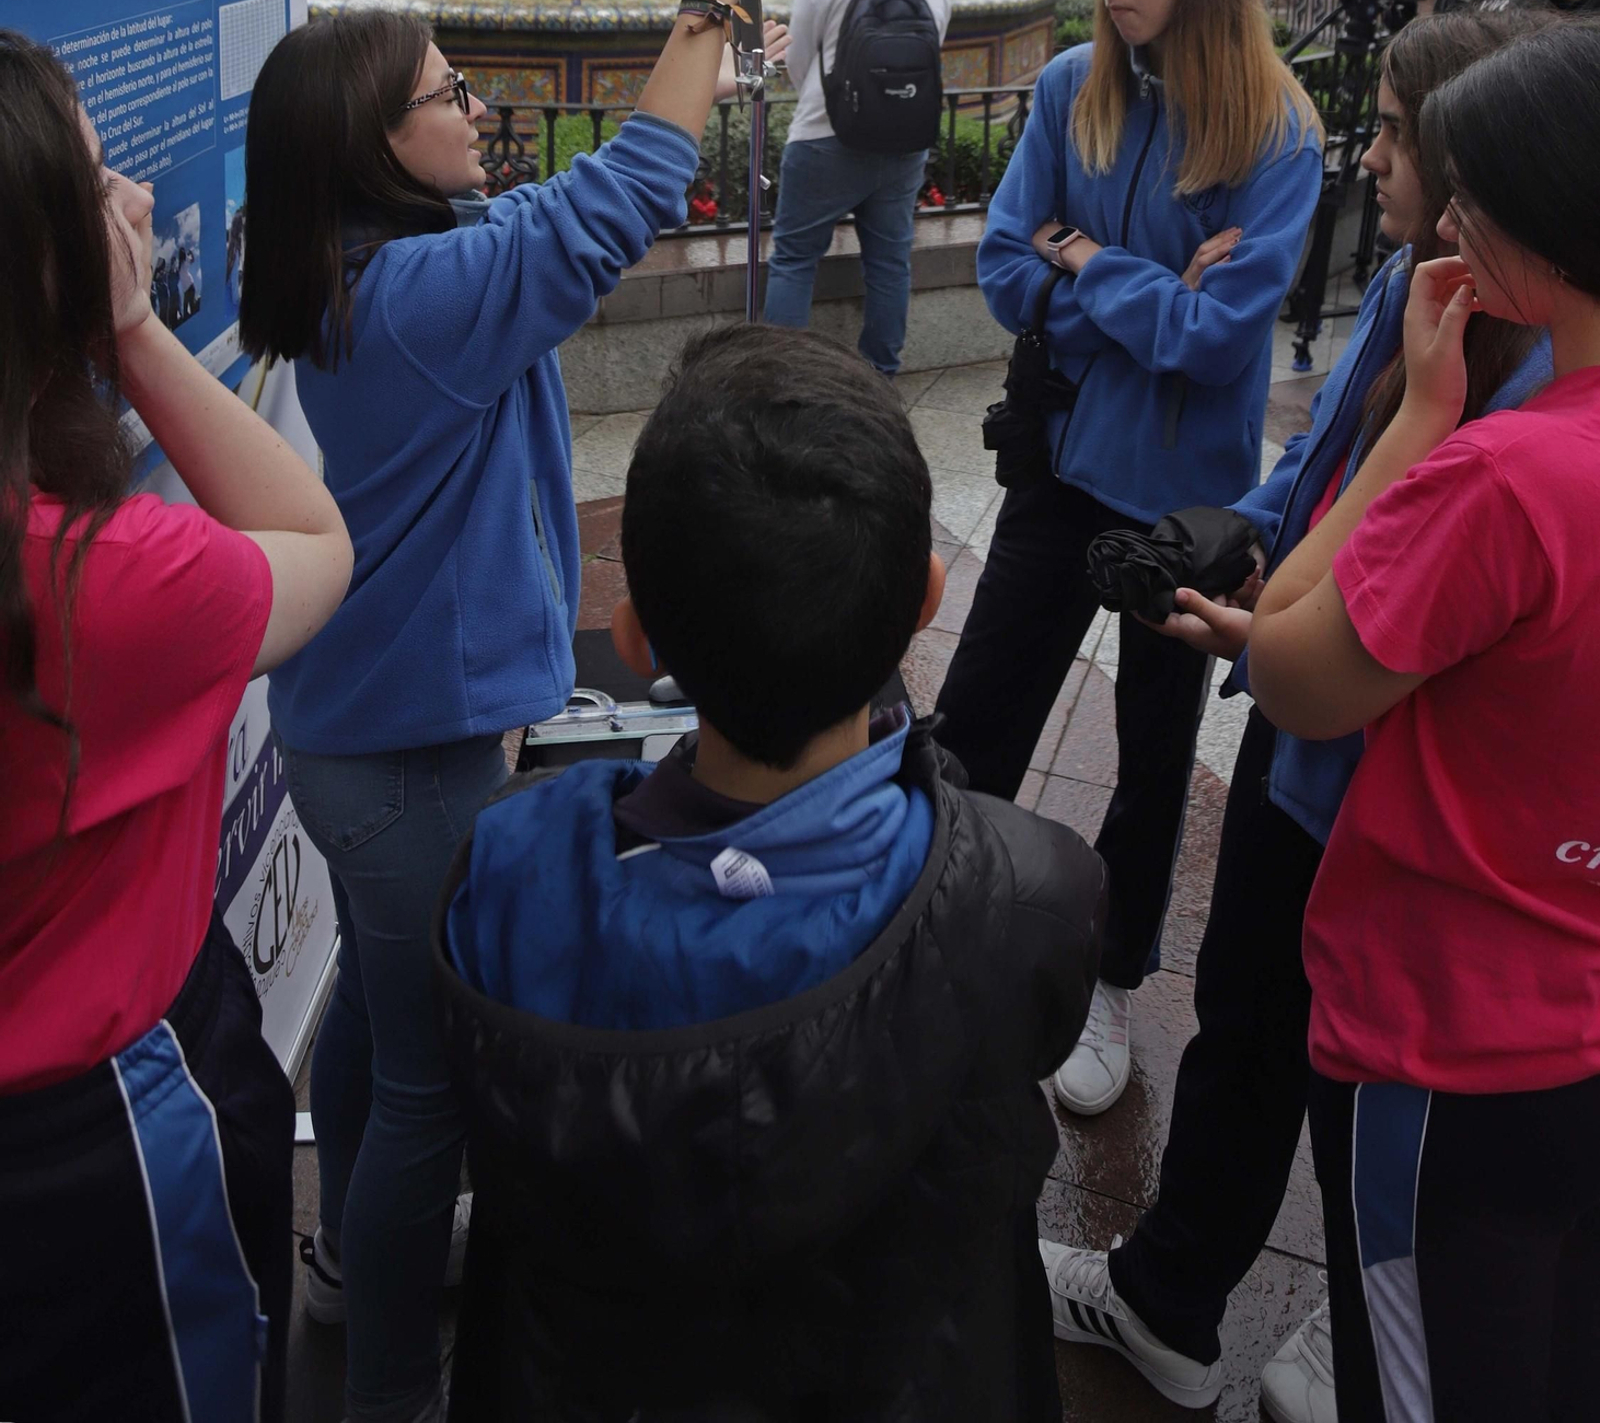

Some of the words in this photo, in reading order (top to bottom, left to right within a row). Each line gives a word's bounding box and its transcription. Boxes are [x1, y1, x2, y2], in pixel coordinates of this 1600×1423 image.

[61, 31, 110, 56] determinación
[111, 28, 120, 41] de
[120, 25, 127, 38] la
[127, 19, 147, 36] latitud
[147, 16, 157, 30] del
[77, 54, 99, 70] noche
[100, 52, 109, 64] se
[111, 43, 131, 63] puede
[133, 34, 166, 53] determinar
[167, 30, 173, 42] la
[174, 26, 190, 40] altura
[191, 21, 200, 34] del
[201, 18, 213, 33] polo
[87, 73, 95, 88] el
[95, 65, 126, 85] horizonte
[127, 54, 156, 74] buscando
[104, 80, 137, 102] hemisferio
[108, 103, 127, 123] punto
[127, 85, 172, 111] correspondiente
[107, 124, 122, 139] Cruz
[122, 117, 132, 133] del
[108, 139, 128, 161] puede
[130, 125, 162, 148] determinar
[134, 149, 148, 166] pasa
[149, 144, 160, 159] por
